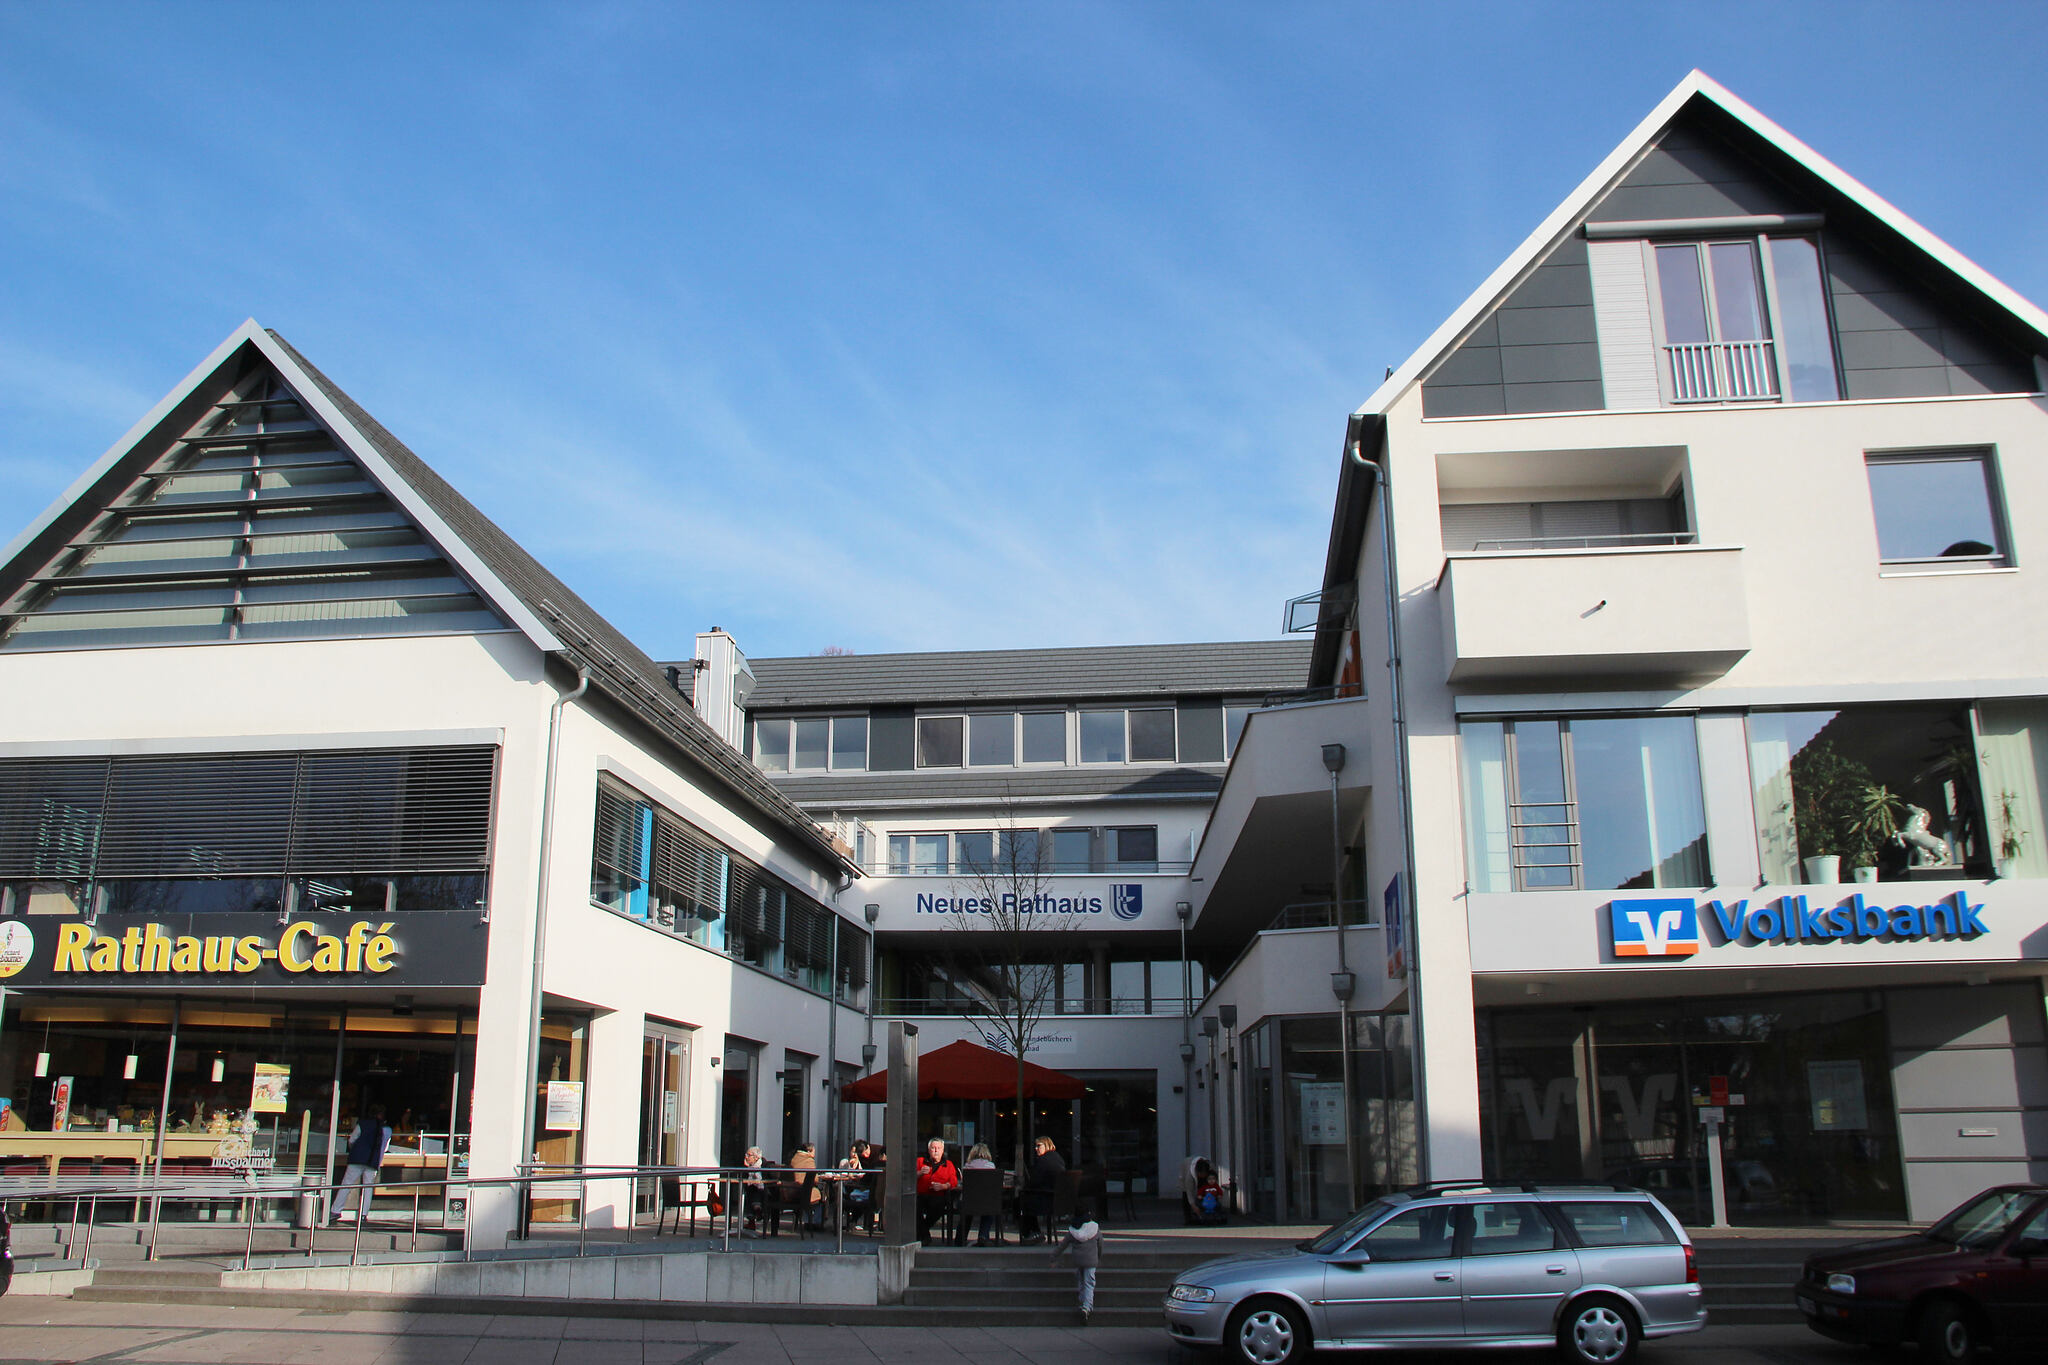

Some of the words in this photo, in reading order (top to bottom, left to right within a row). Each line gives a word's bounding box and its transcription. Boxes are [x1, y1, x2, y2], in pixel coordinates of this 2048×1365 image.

[916, 893, 993, 914] Neues
[1002, 893, 1103, 914] Rathaus
[1710, 890, 1991, 941] Volksbank
[53, 920, 397, 973] Rathaus-Café
[1011, 1034, 1072, 1043] Geindebücherei
